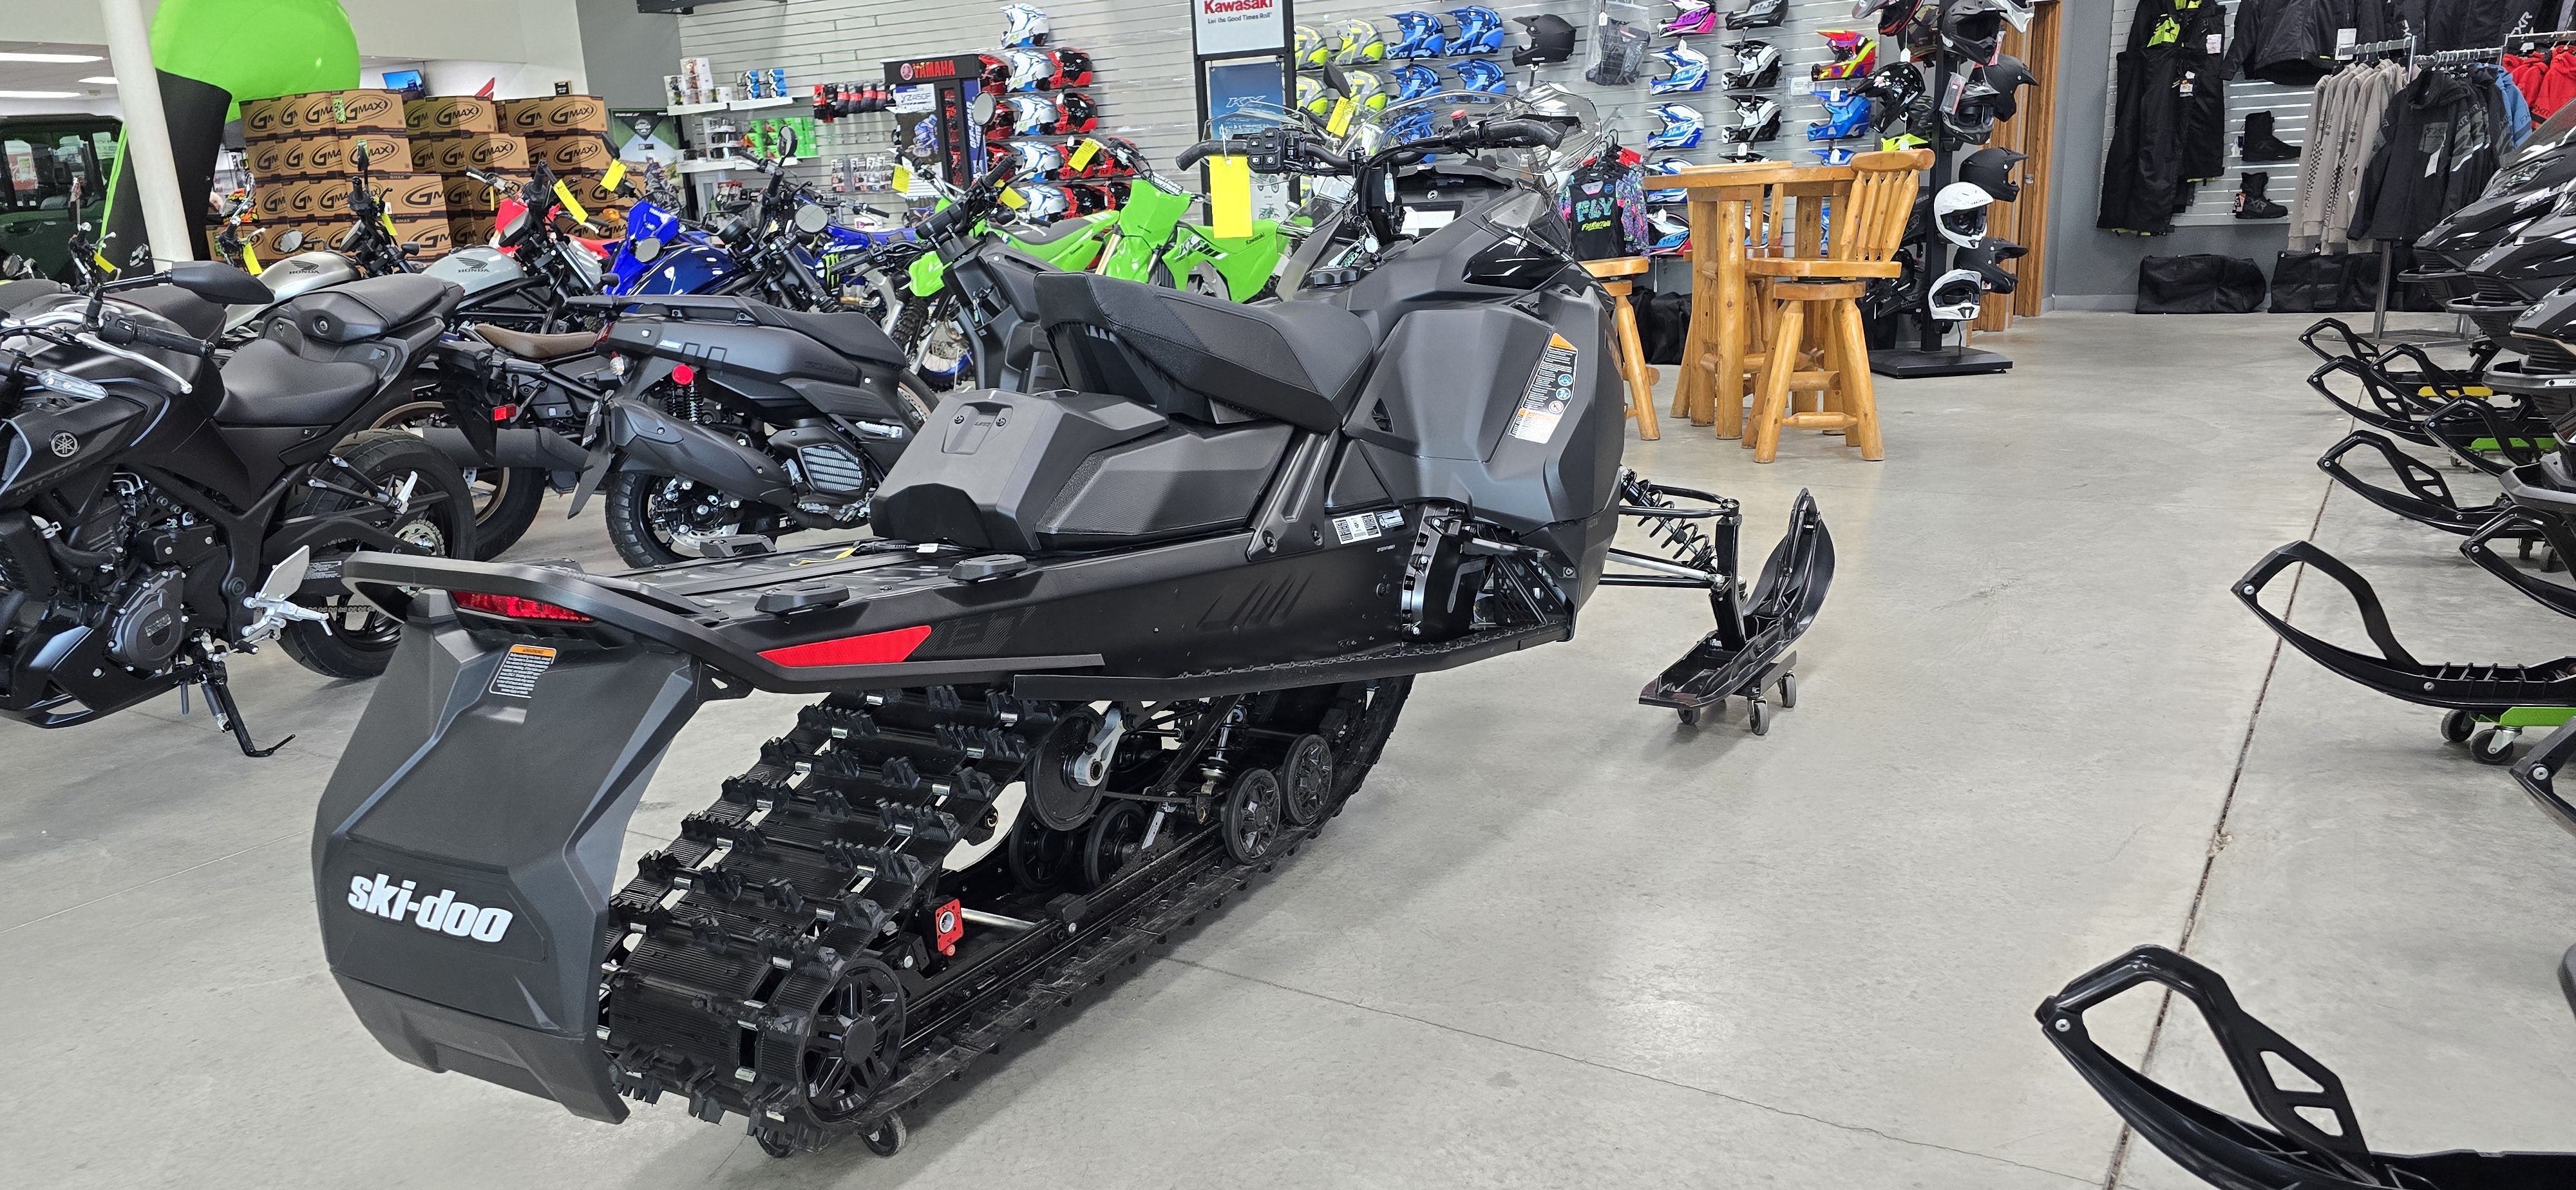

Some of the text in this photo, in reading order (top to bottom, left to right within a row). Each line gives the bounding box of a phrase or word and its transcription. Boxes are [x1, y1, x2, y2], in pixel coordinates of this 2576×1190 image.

[1204, 0, 1273, 14] Kawasaki
[1681, 8, 1707, 22] HJC
[1754, 0, 1779, 14] HJC
[912, 60, 956, 79] YAMAHA
[1676, 65, 1702, 80] HJC
[900, 93, 931, 103] YZ450F
[435, 104, 479, 126] GMAX
[549, 104, 594, 126] GMAX
[1667, 122, 1693, 137] HJC
[471, 142, 513, 164] GMAX
[554, 142, 598, 165] GMAX
[1575, 197, 1614, 222] FLY
[1245, 232, 1265, 245] Kawasaki
[1661, 231, 1687, 245] HJC
[16, 462, 81, 496] MT-03
[348, 873, 513, 942] ski-doo
